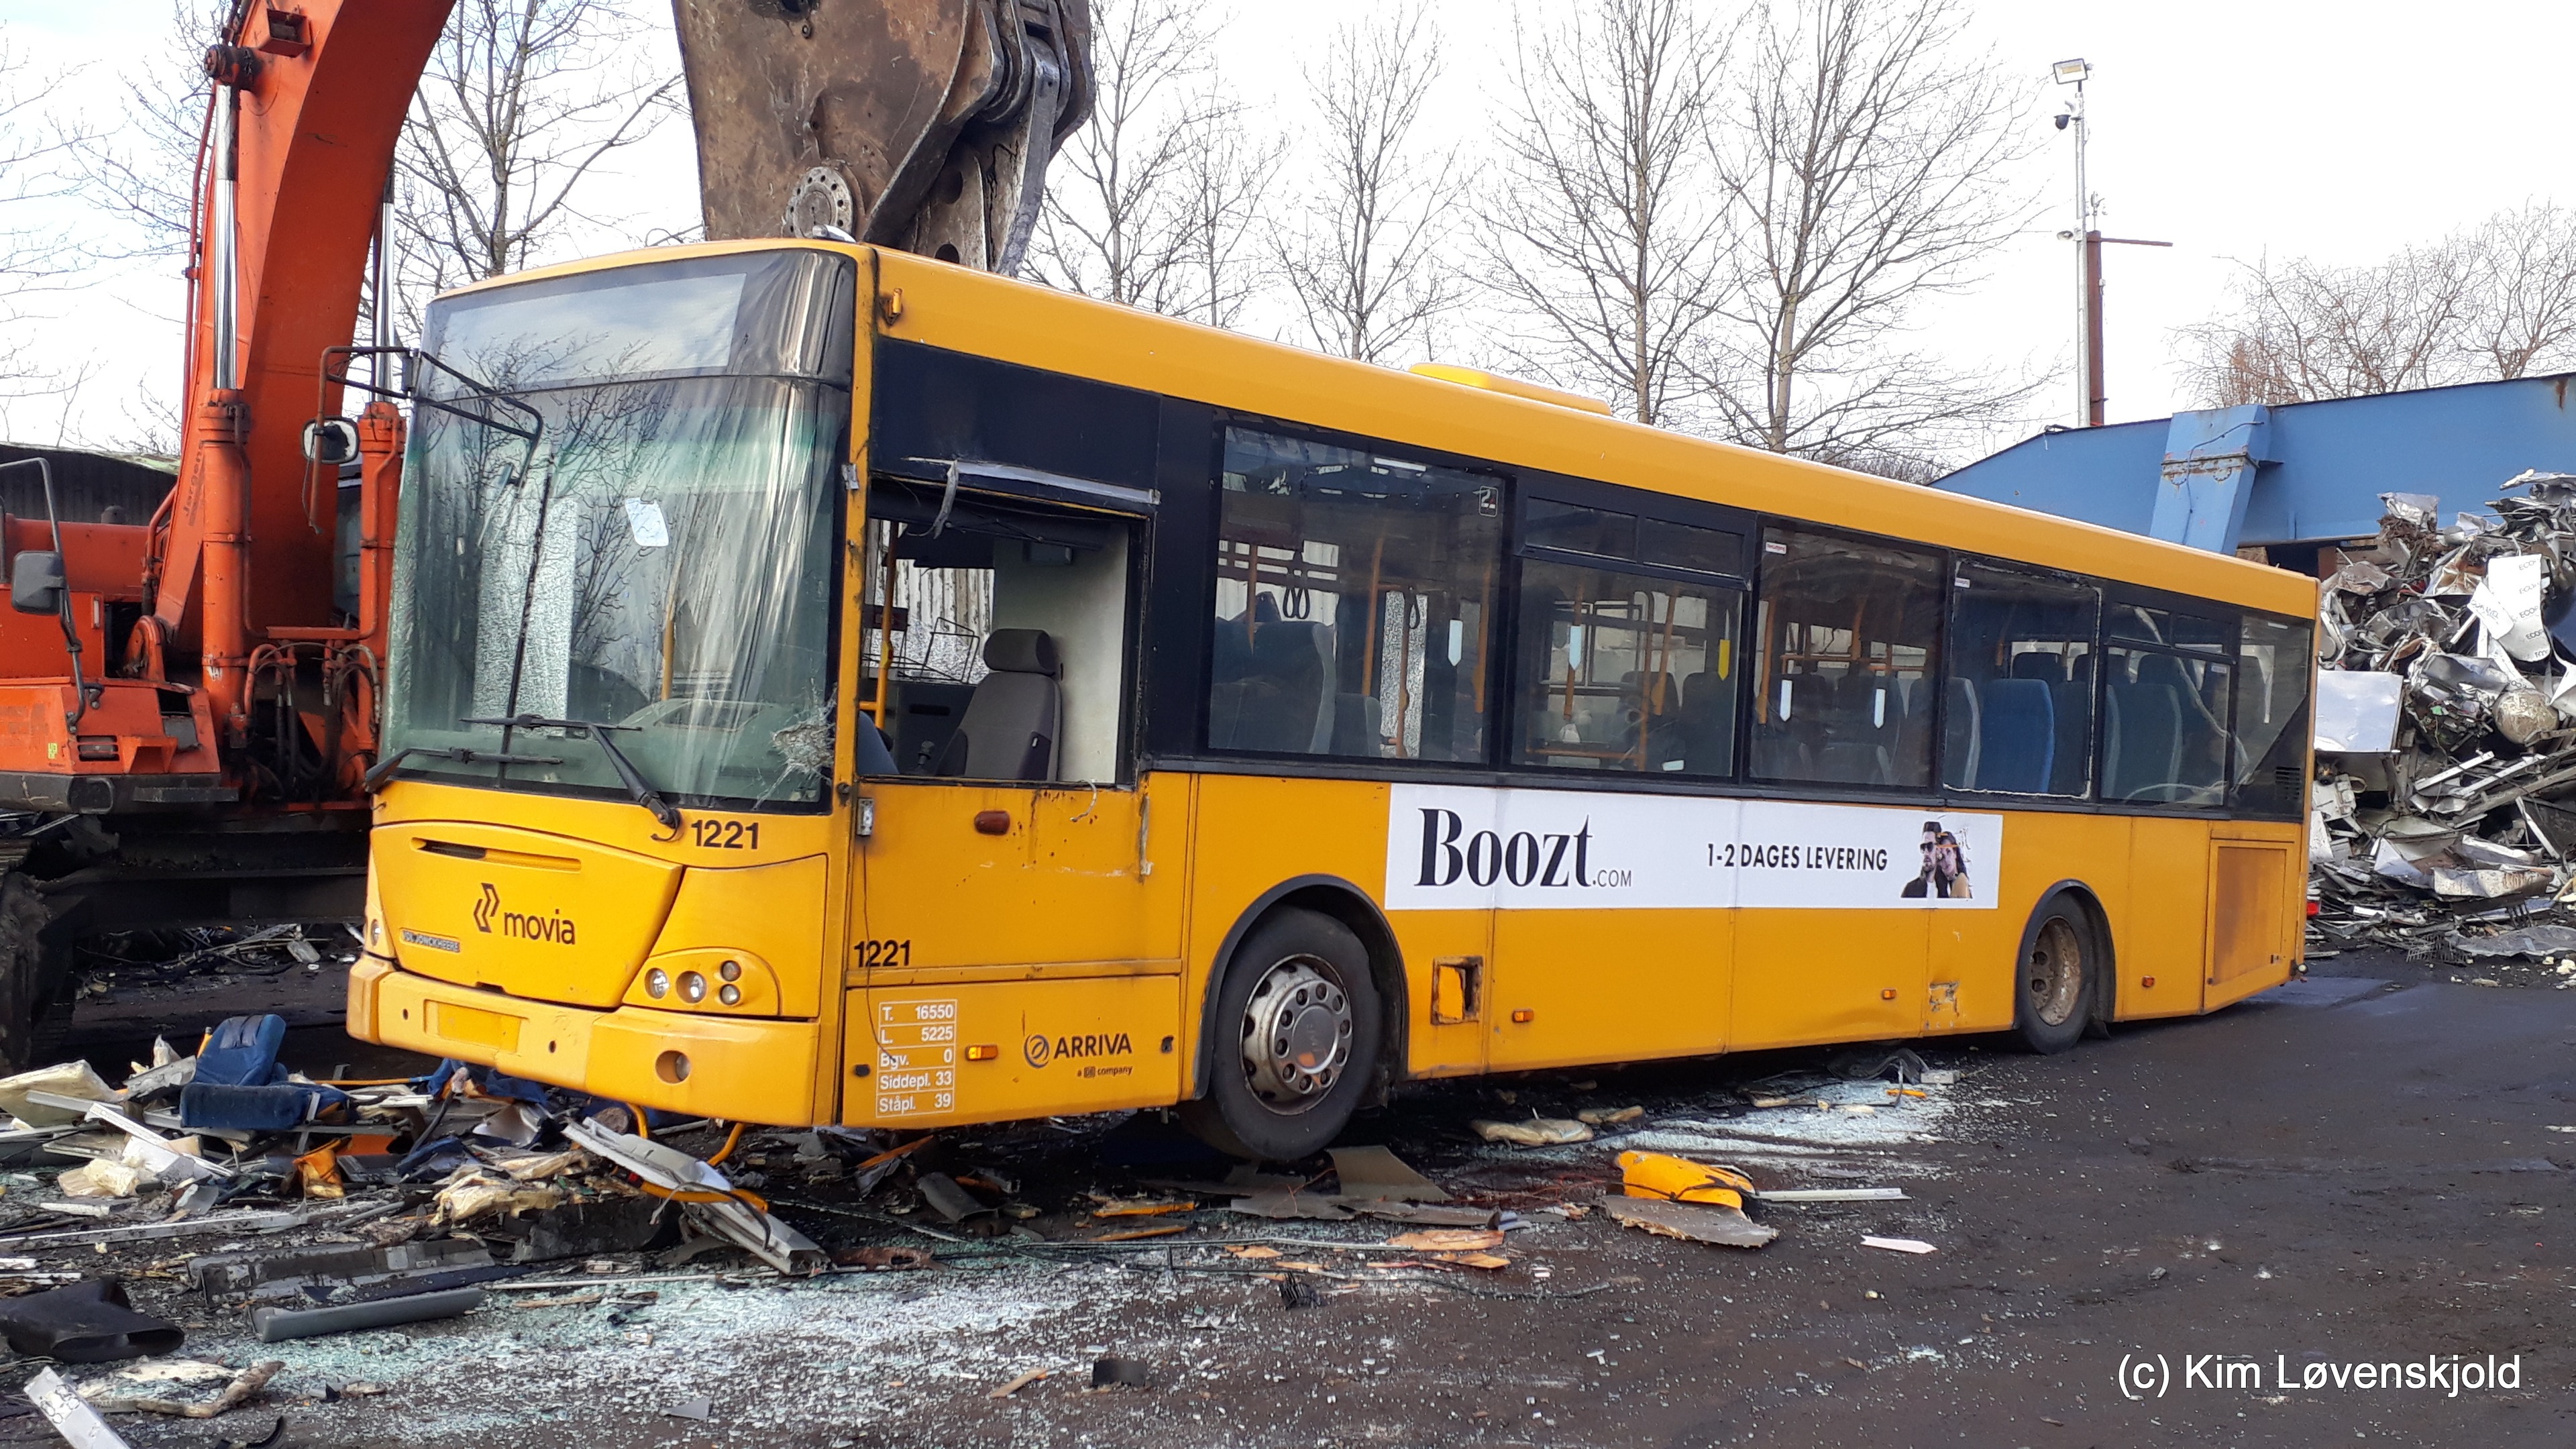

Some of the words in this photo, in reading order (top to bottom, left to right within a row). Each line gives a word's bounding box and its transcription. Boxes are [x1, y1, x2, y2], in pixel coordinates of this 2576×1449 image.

[691, 819, 759, 849] 1221
[1708, 843, 1735, 867] 1-2
[1741, 844, 1800, 868] DAGES
[1807, 847, 1888, 871] LEVERING
[504, 908, 576, 945] movia
[854, 940, 910, 967] 1221
[882, 1006, 894, 1021] T.
[915, 1004, 953, 1020] 16550
[881, 1029, 893, 1044] L.
[921, 1026, 953, 1042] 5225
[1053, 1033, 1132, 1059] ARRIVA
[880, 1052, 909, 1069] Bgv.
[943, 1049, 953, 1063] 0
[880, 1073, 931, 1090] Siddepl.
[935, 1071, 952, 1085] 33
[1097, 1066, 1133, 1077] company
[879, 1095, 916, 1114] Ståpl.
[934, 1093, 951, 1108] 39
